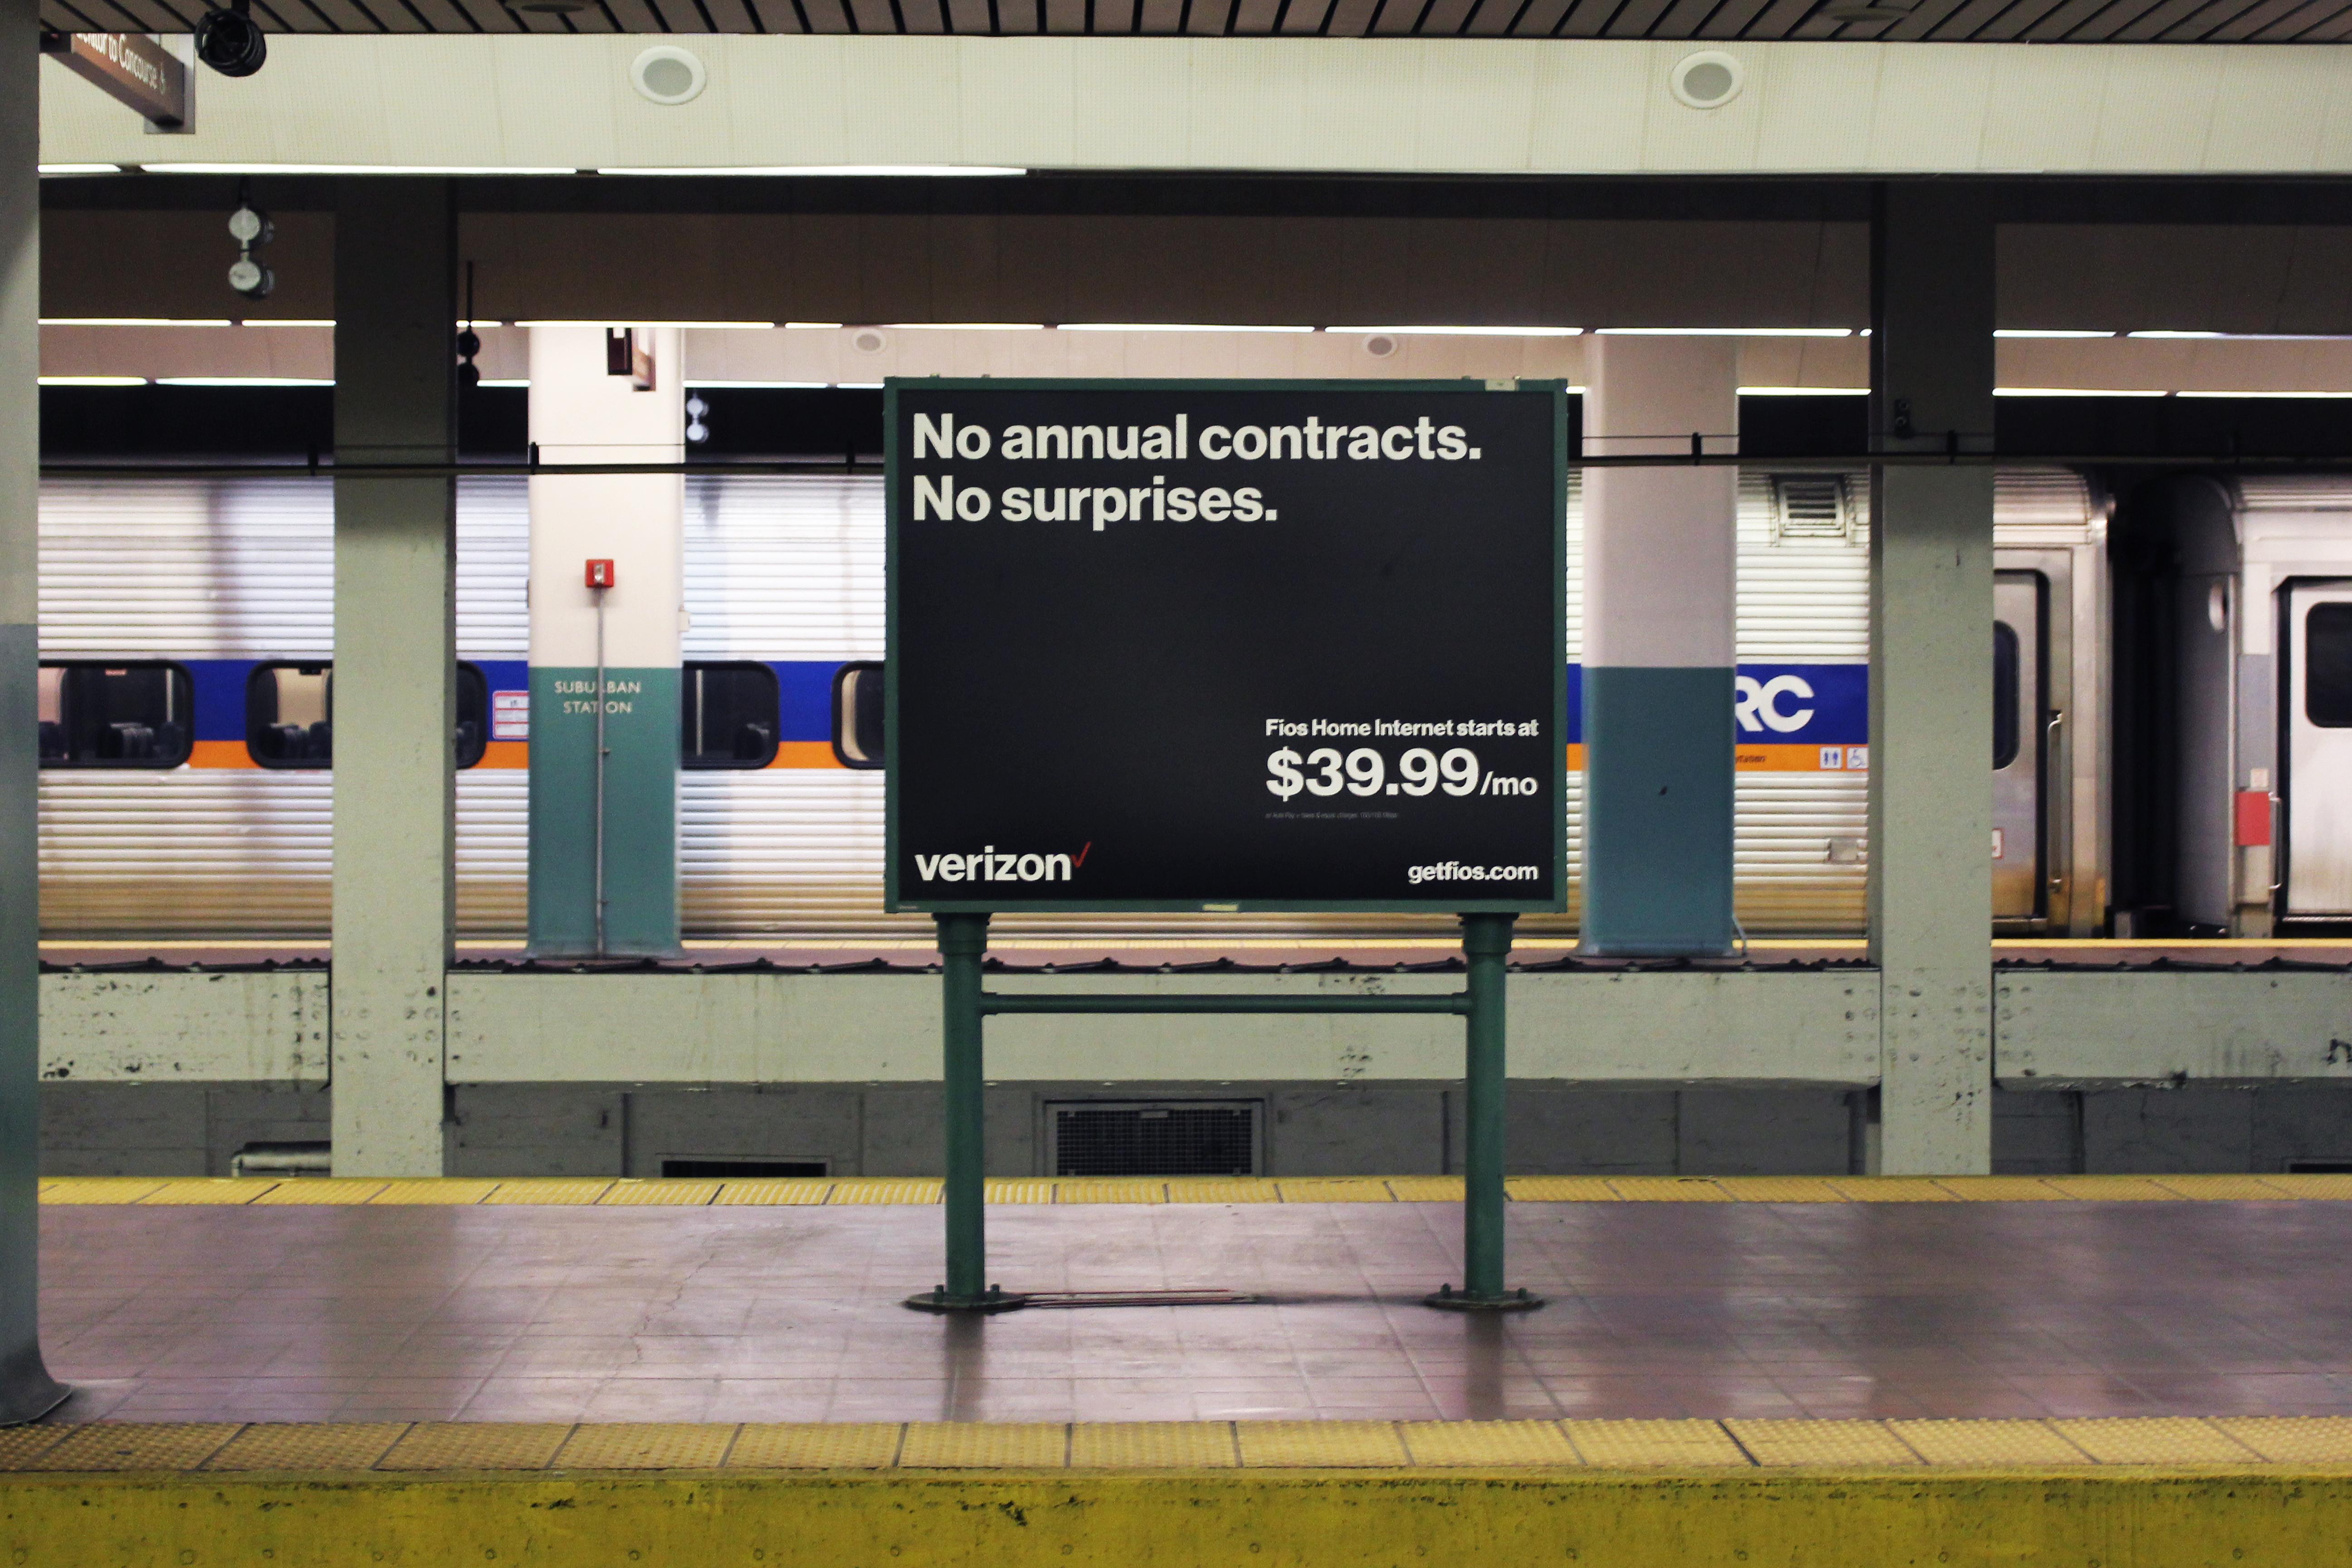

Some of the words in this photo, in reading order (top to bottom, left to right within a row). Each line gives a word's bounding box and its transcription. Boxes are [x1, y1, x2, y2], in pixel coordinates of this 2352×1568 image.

[108, 34, 119, 63] to
[119, 33, 158, 90] Concourse
[913, 413, 992, 460] No
[1001, 413, 1188, 460] annual
[1199, 416, 1481, 460] contracts.
[913, 475, 992, 521] No
[1001, 475, 1277, 532] surprises.
[554, 680, 641, 694] SUBUBAN
[563, 701, 632, 714] STATON
[1265, 718, 1308, 736] Fios
[1312, 718, 1372, 736] Home
[1375, 718, 1454, 736] Internet
[1456, 719, 1516, 736] starts
[1518, 719, 1539, 736] at
[914, 845, 1071, 882] verizon
[1408, 862, 1539, 884] getfios.com
